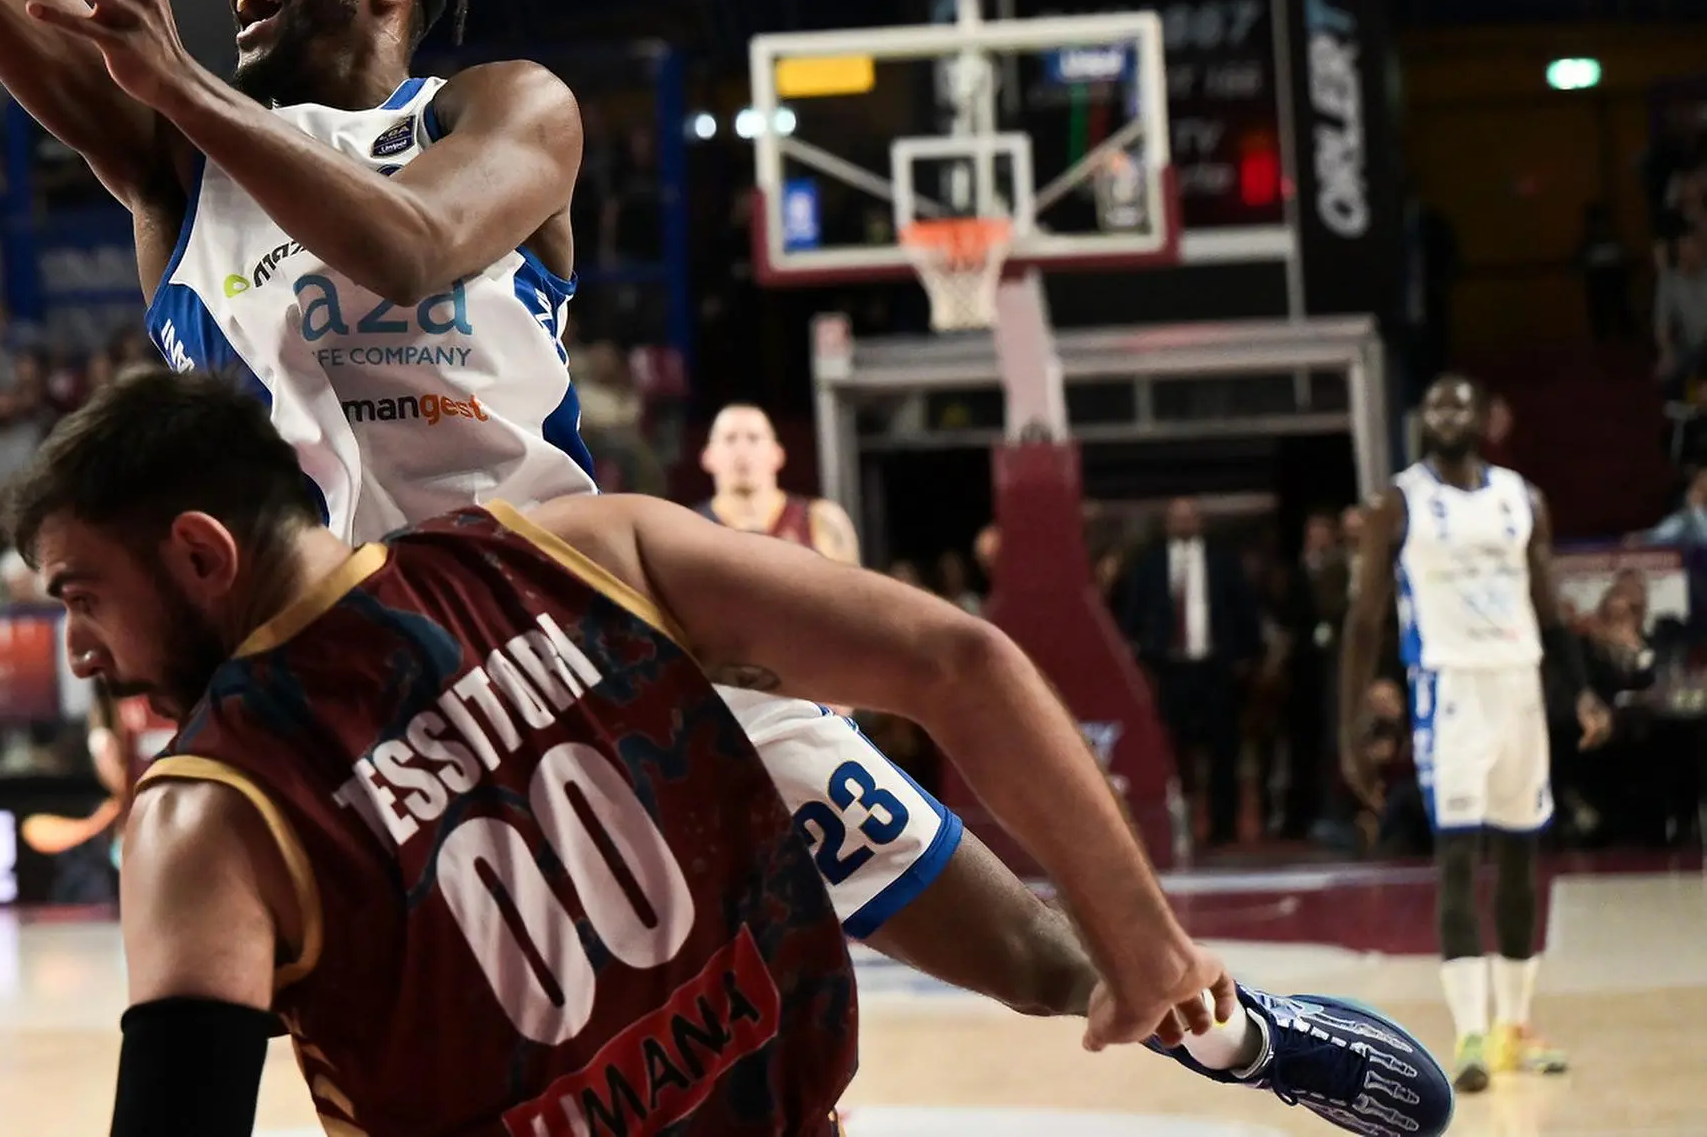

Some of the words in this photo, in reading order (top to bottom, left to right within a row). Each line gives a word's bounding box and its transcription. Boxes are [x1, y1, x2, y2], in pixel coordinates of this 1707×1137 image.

[350, 348, 472, 367] COMPANY
[342, 394, 489, 426] mangest
[793, 760, 909, 886] 23
[436, 742, 694, 1046] 00
